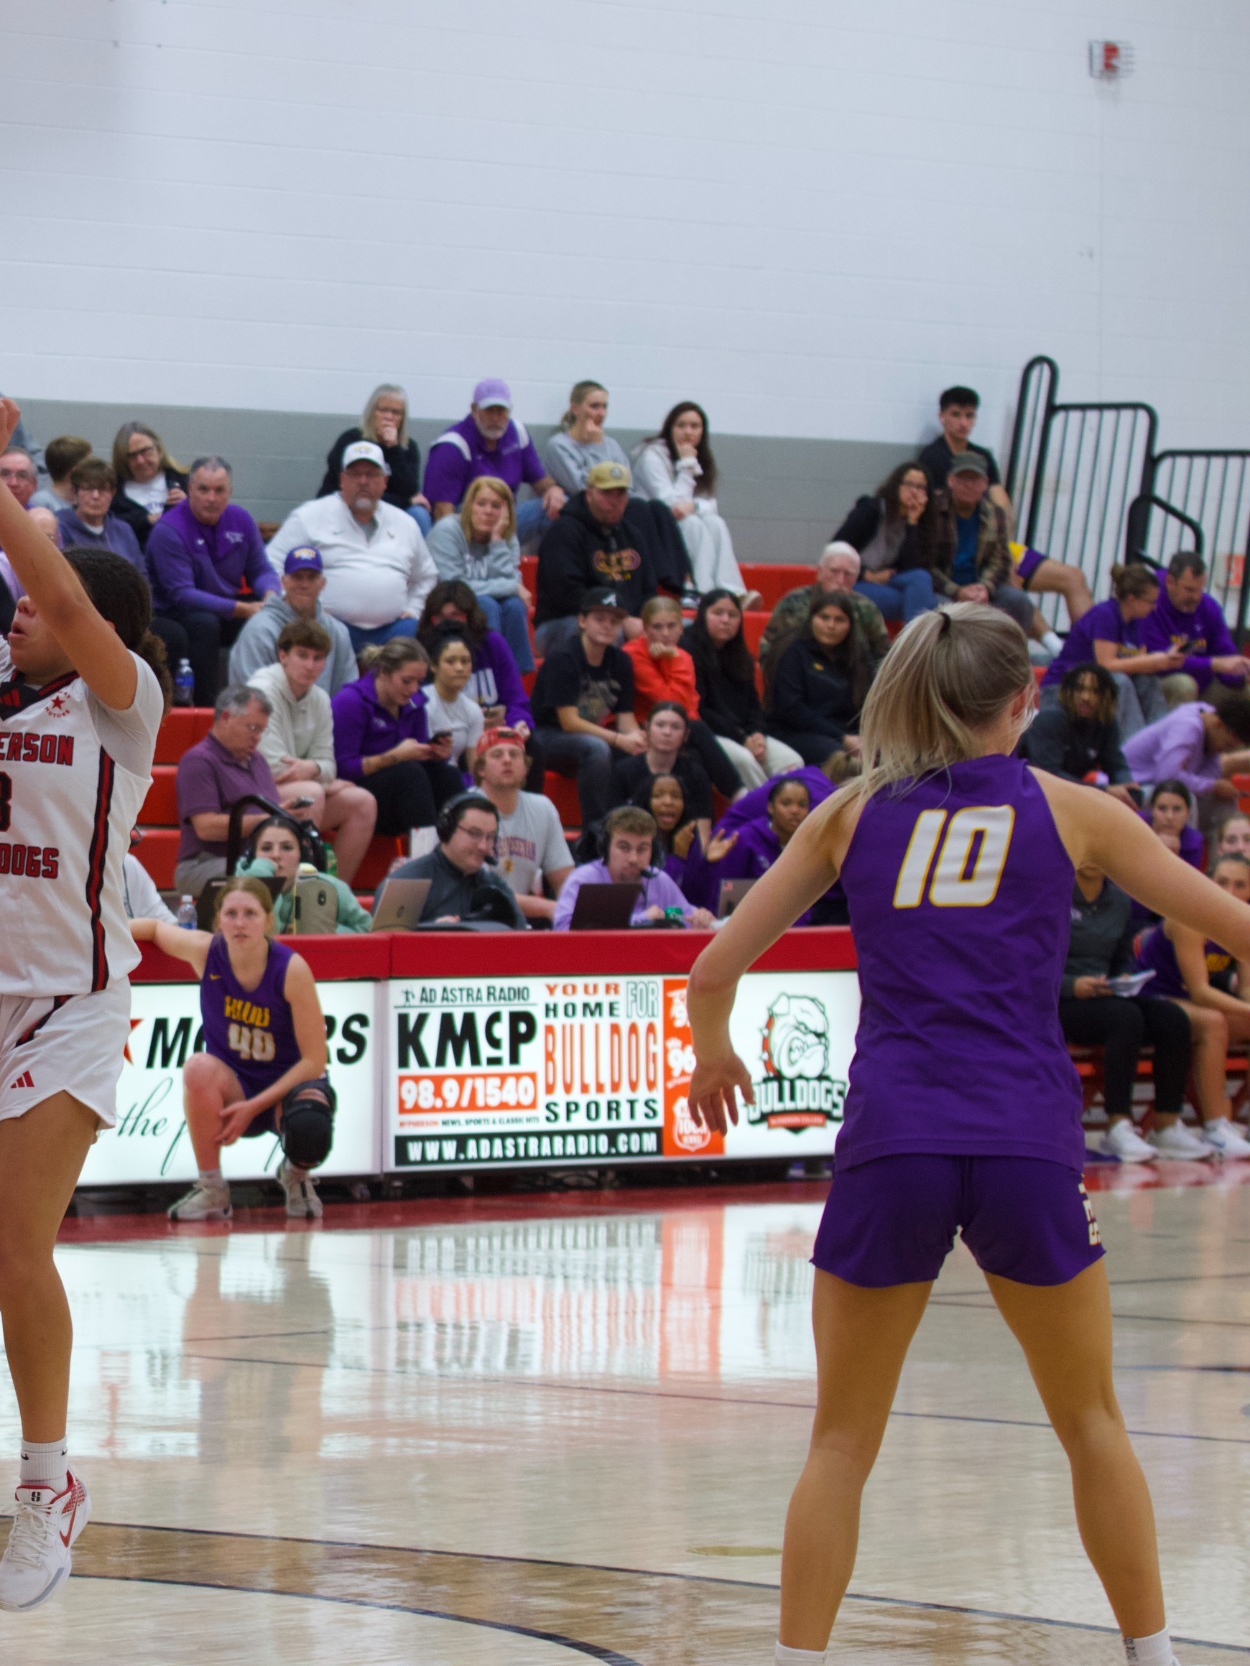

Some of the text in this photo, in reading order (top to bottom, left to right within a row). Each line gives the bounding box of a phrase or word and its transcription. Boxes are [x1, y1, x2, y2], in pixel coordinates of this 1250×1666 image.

[893, 805, 1015, 909] 10
[545, 982, 621, 997] YOUR
[545, 1001, 621, 1019] HOME
[626, 980, 660, 1020] FOR
[229, 1023, 276, 1061] 40
[544, 1021, 659, 1096] BULLDOG
[400, 1075, 536, 1110] 98.9/1540
[545, 1097, 659, 1124] SPORTS
[406, 1131, 658, 1164] WWW.ADASTRARADIO.COM
